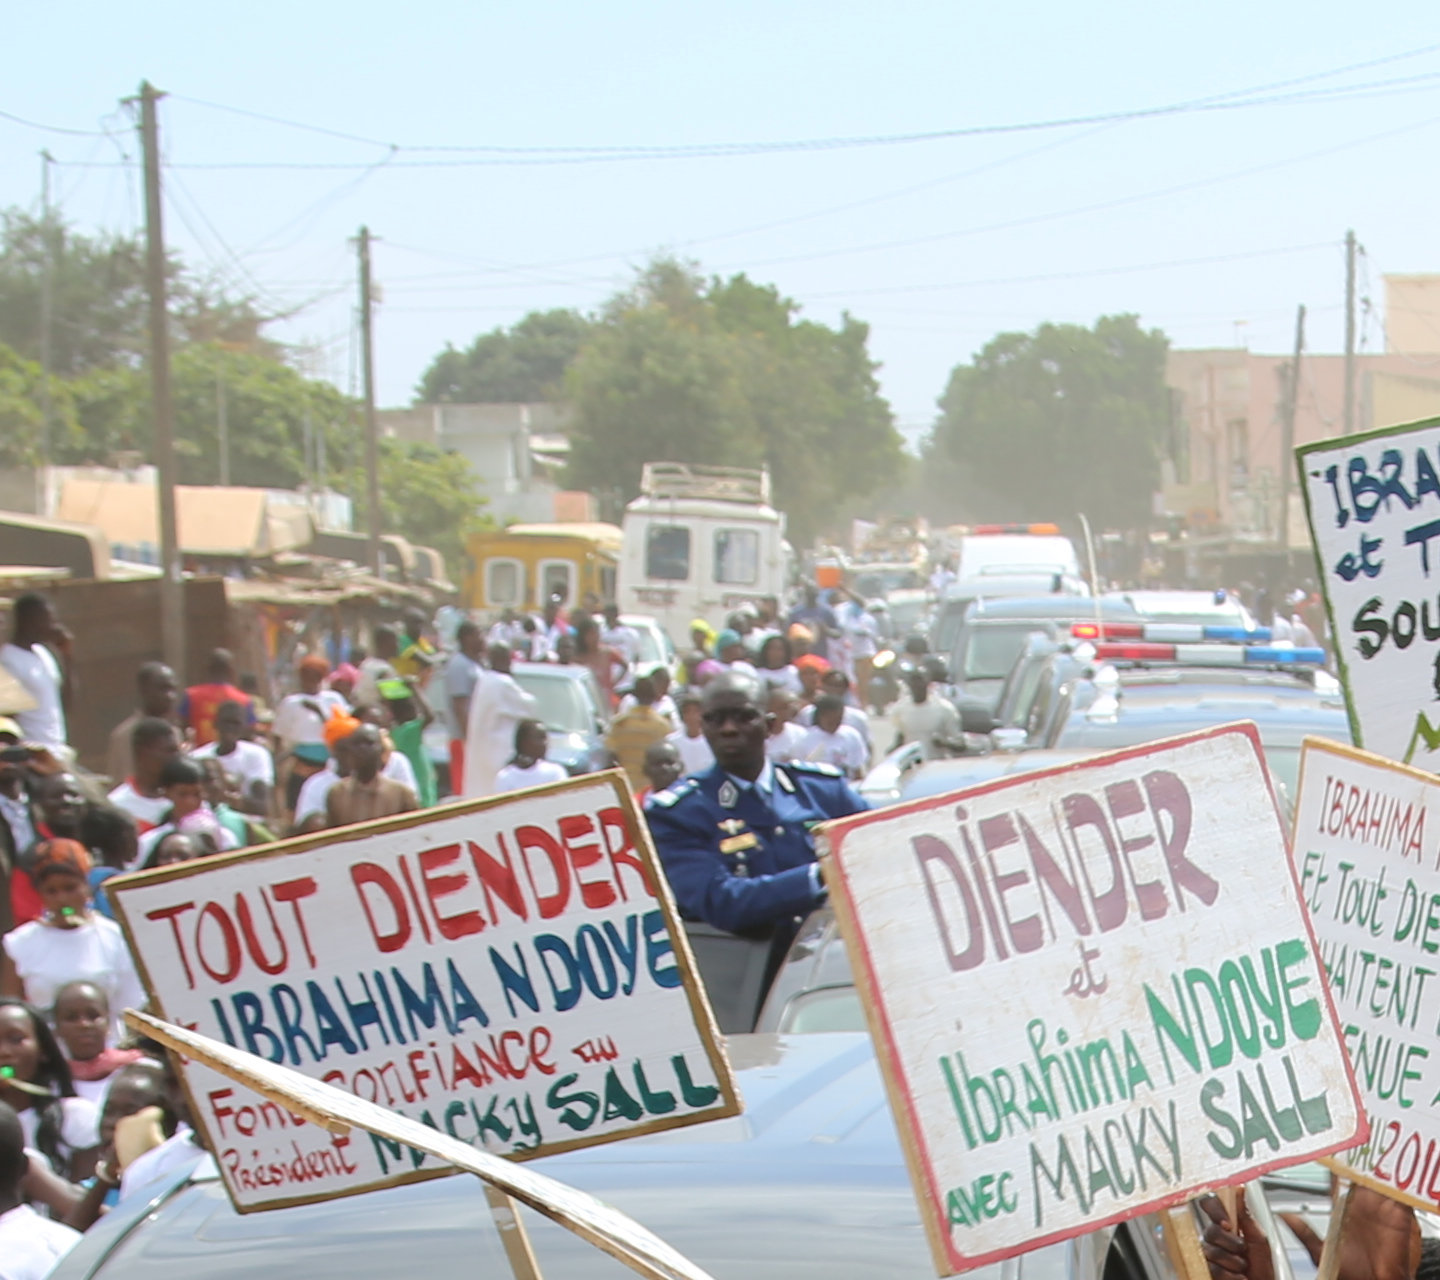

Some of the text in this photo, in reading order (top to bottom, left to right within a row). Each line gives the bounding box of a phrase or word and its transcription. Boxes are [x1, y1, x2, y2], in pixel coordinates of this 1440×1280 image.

[1335, 532, 1384, 582] et
[1319, 776, 1424, 865] IBRAHIMA
[147, 807, 658, 990] TOUT DIENDER
[211, 958, 489, 1067] IBRAHIMA
[490, 910, 684, 1020] NDOYE
[1063, 939, 1107, 999] et
[547, 1054, 721, 1134] SALL
[946, 1056, 1334, 1231] AVEC MACKY SALL
